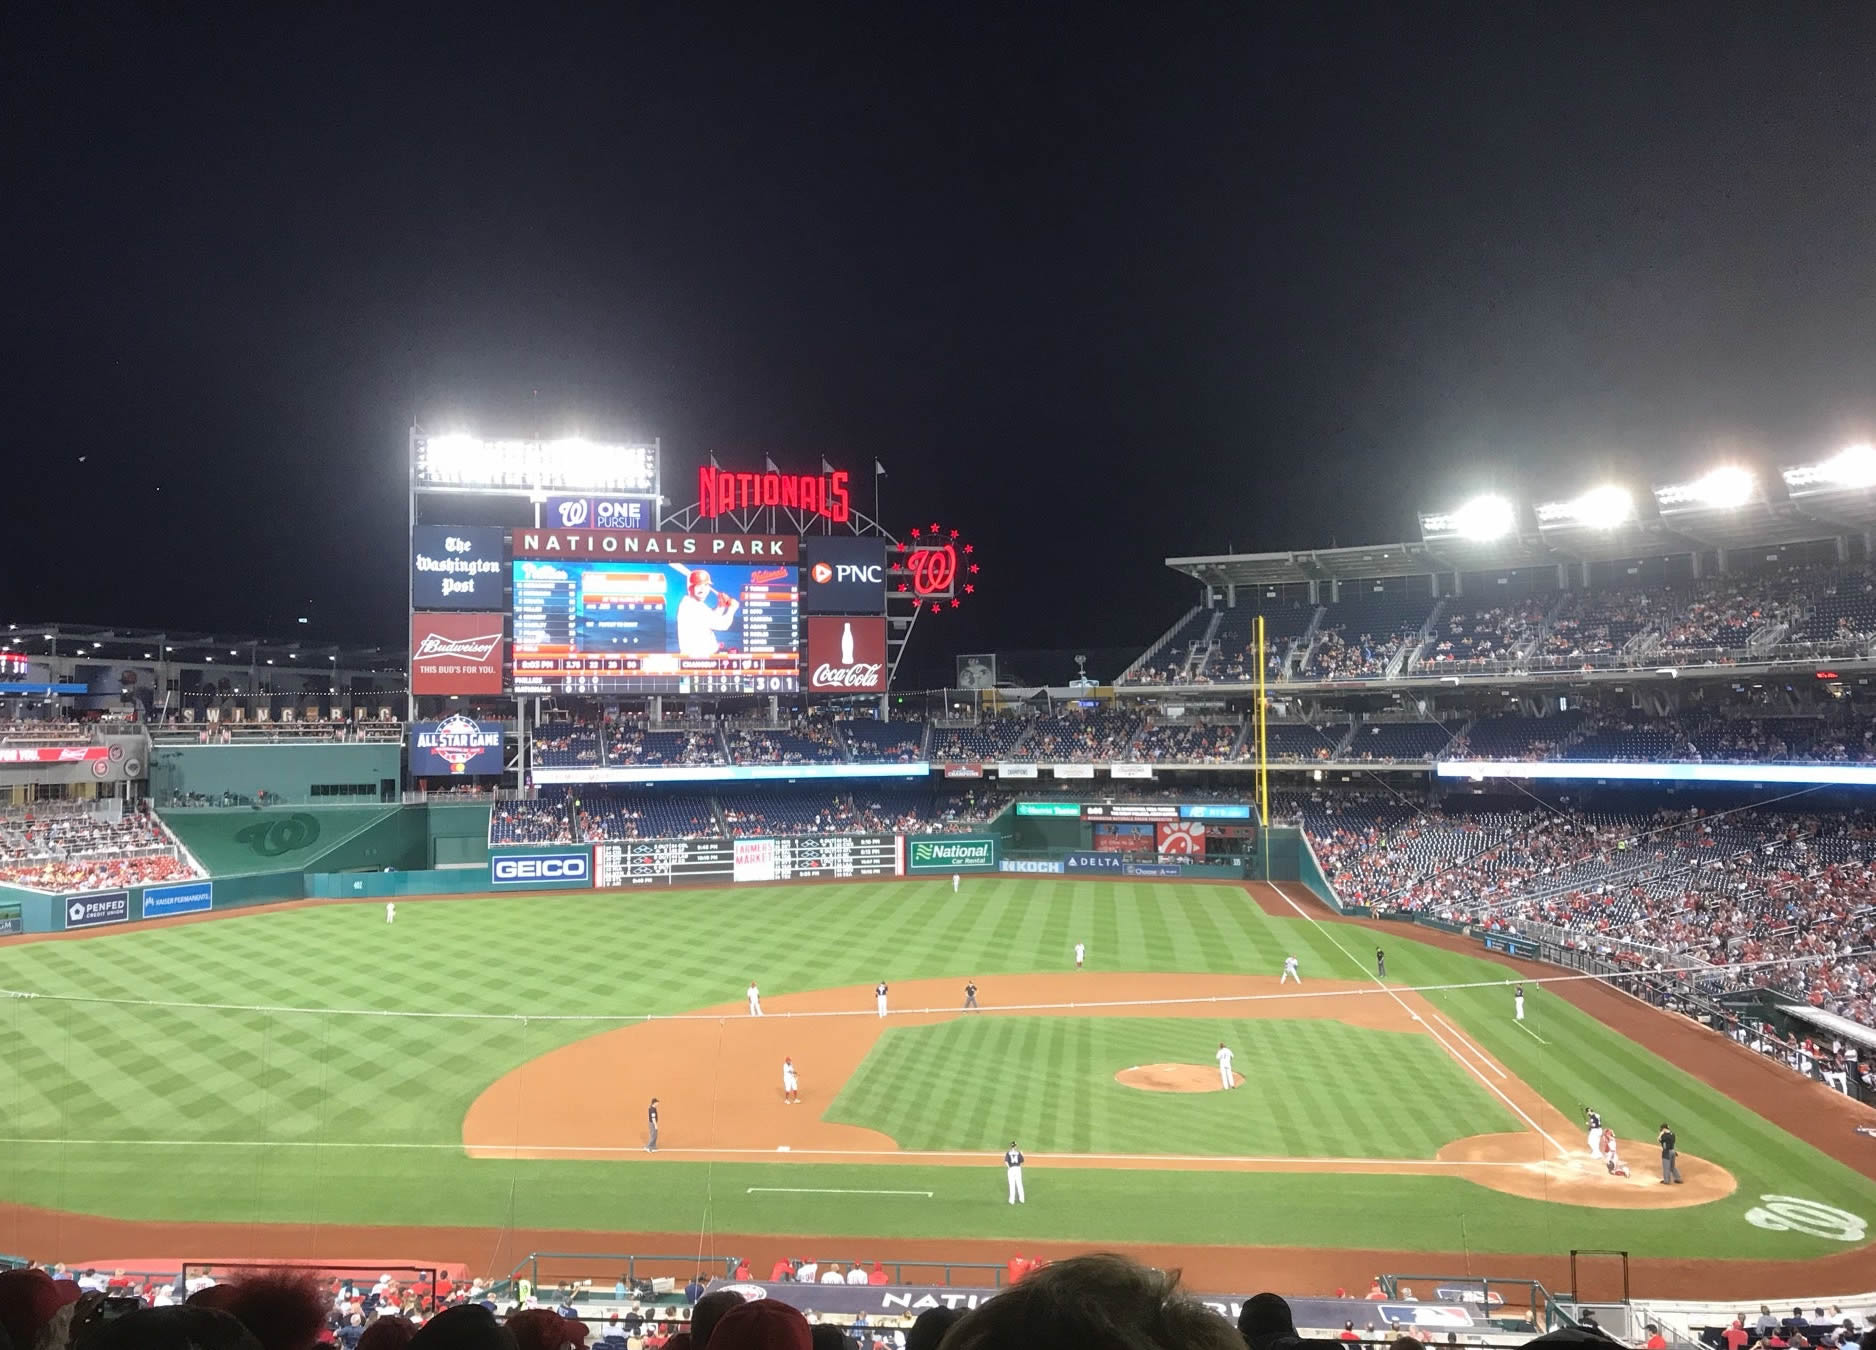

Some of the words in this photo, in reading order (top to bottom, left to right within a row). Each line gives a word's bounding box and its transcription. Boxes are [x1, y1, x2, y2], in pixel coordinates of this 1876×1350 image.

[700, 466, 848, 522] NATIONALS
[598, 502, 641, 517] ONE
[598, 517, 641, 528] PURSUIT
[445, 537, 472, 553] The
[524, 535, 696, 553] NATIONALS
[713, 540, 783, 555] PARK
[416, 554, 500, 576] Washington
[835, 565, 882, 583] PNC
[441, 579, 475, 596] Post
[421, 638, 493, 654] Budweiser
[420, 666, 438, 674] THIS
[439, 666, 461, 674] BUD'S
[462, 666, 477, 674] FOR
[478, 666, 496, 674] YOU.
[756, 677, 765, 691] 3
[770, 677, 780, 691] 0
[786, 677, 793, 691] 1
[417, 733, 440, 747] ALL
[440, 733, 467, 747] STAR
[469, 733, 499, 747] GAME
[932, 844, 988, 858] National
[495, 859, 585, 878] GEICO
[1016, 861, 1059, 872] KOCH
[1081, 857, 1119, 866] DELTA
[86, 900, 125, 912] PENFED
[156, 897, 174, 906] KAISER
[107, 909, 124, 917] UNION
